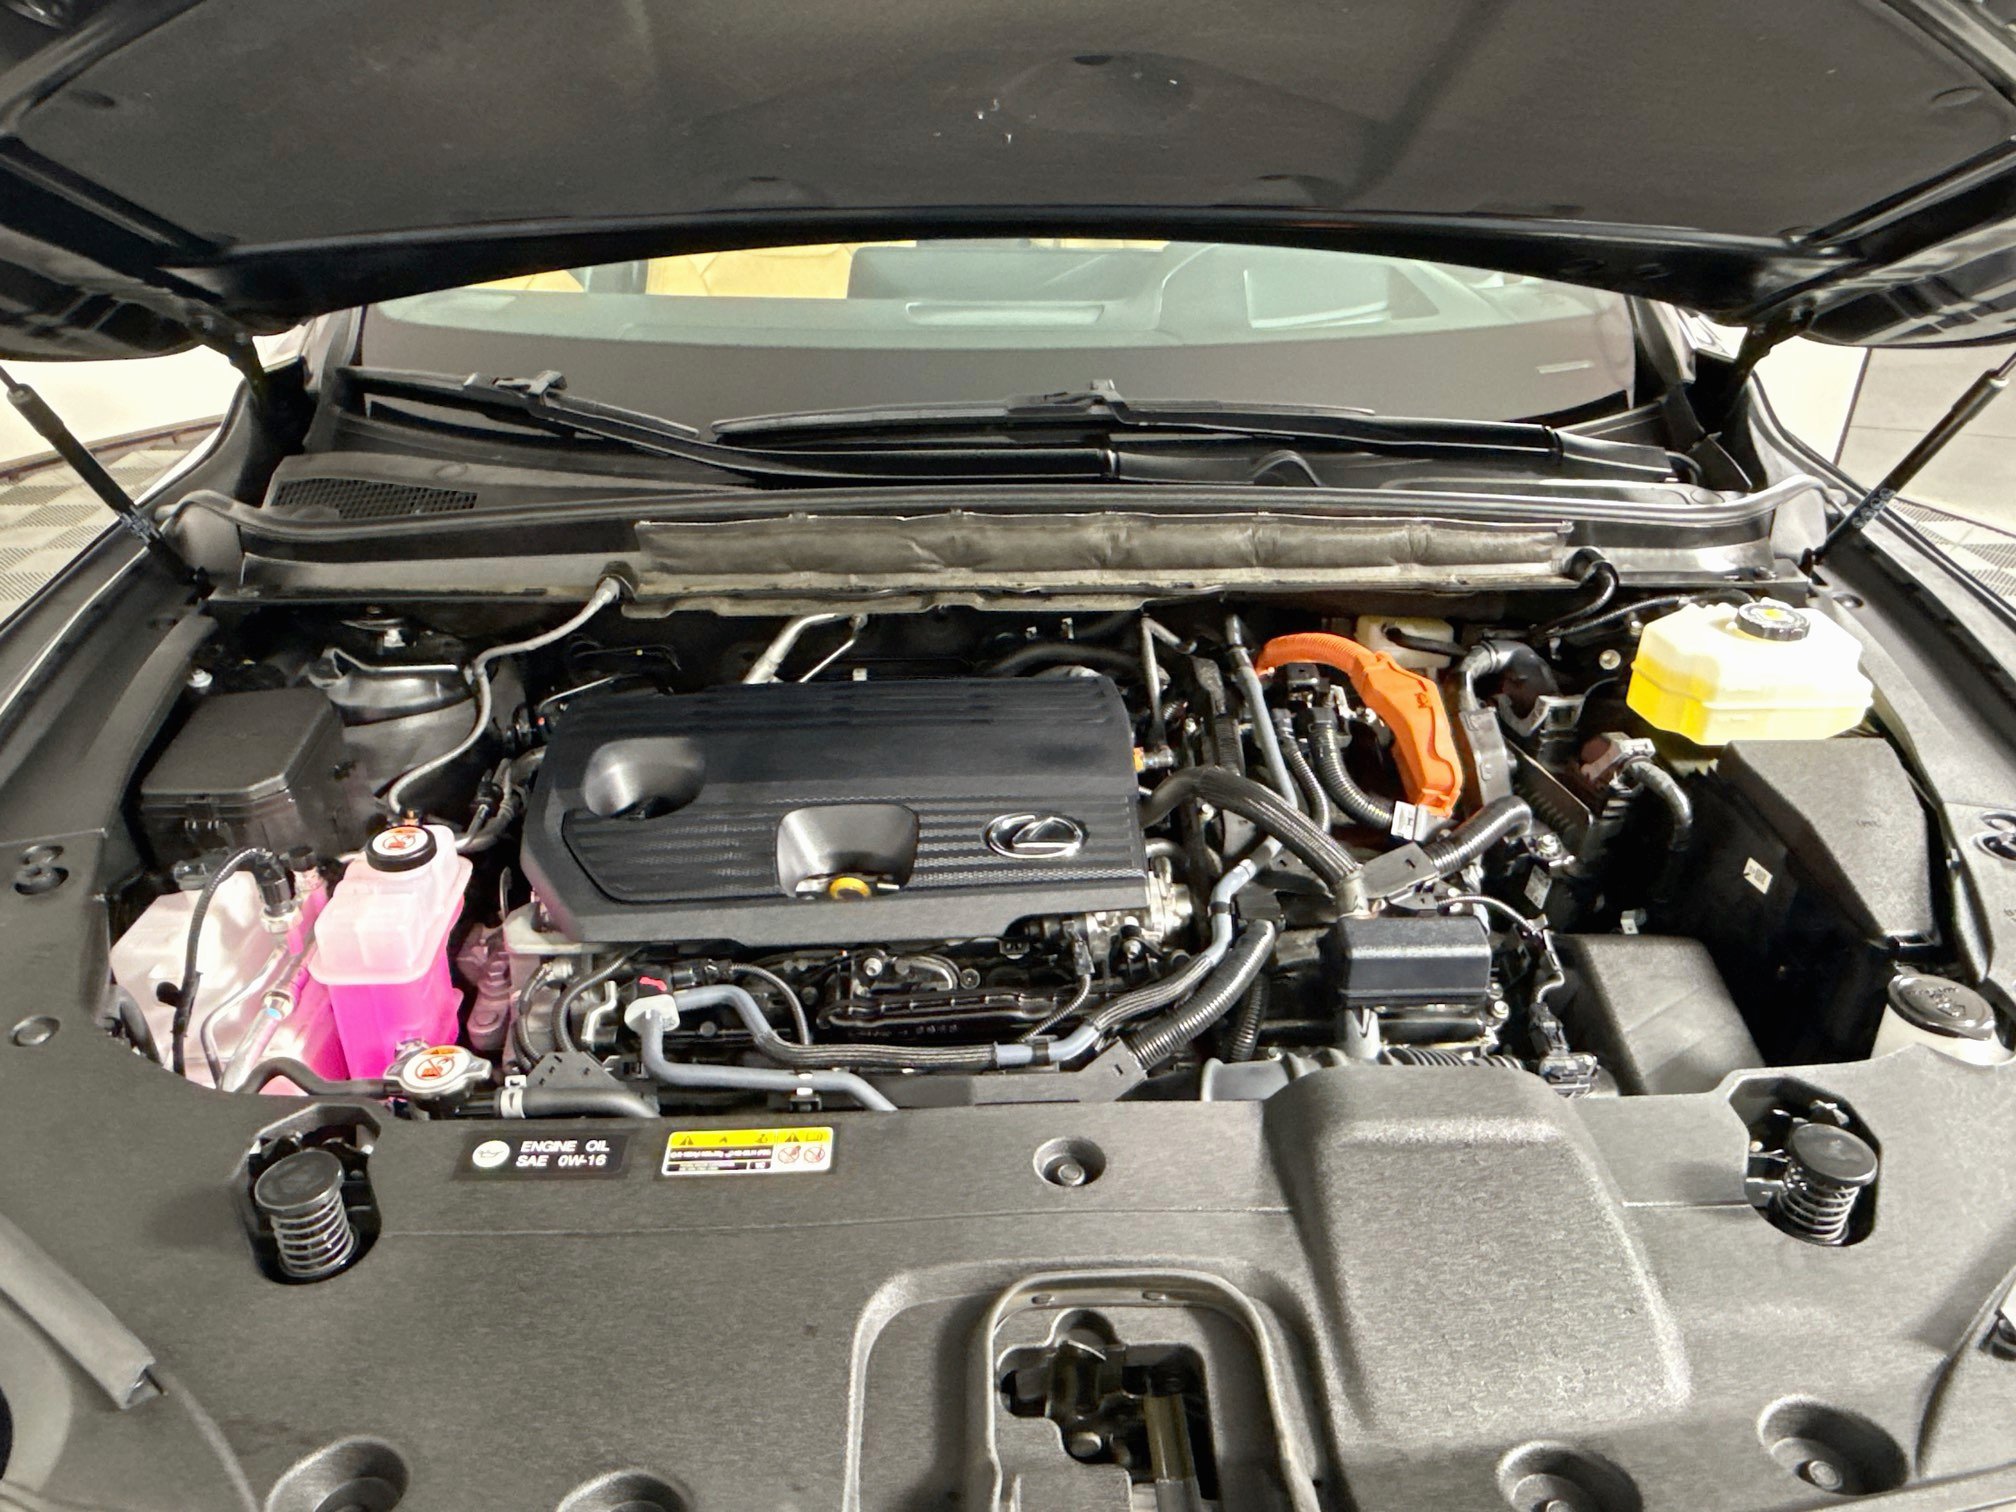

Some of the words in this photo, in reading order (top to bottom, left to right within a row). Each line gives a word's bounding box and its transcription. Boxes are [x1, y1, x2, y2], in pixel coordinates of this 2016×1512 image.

[520, 1140, 578, 1153] ENGINE
[585, 1139, 611, 1152] OIL
[515, 1154, 550, 1167] SAE
[557, 1153, 608, 1167] 0W-16
